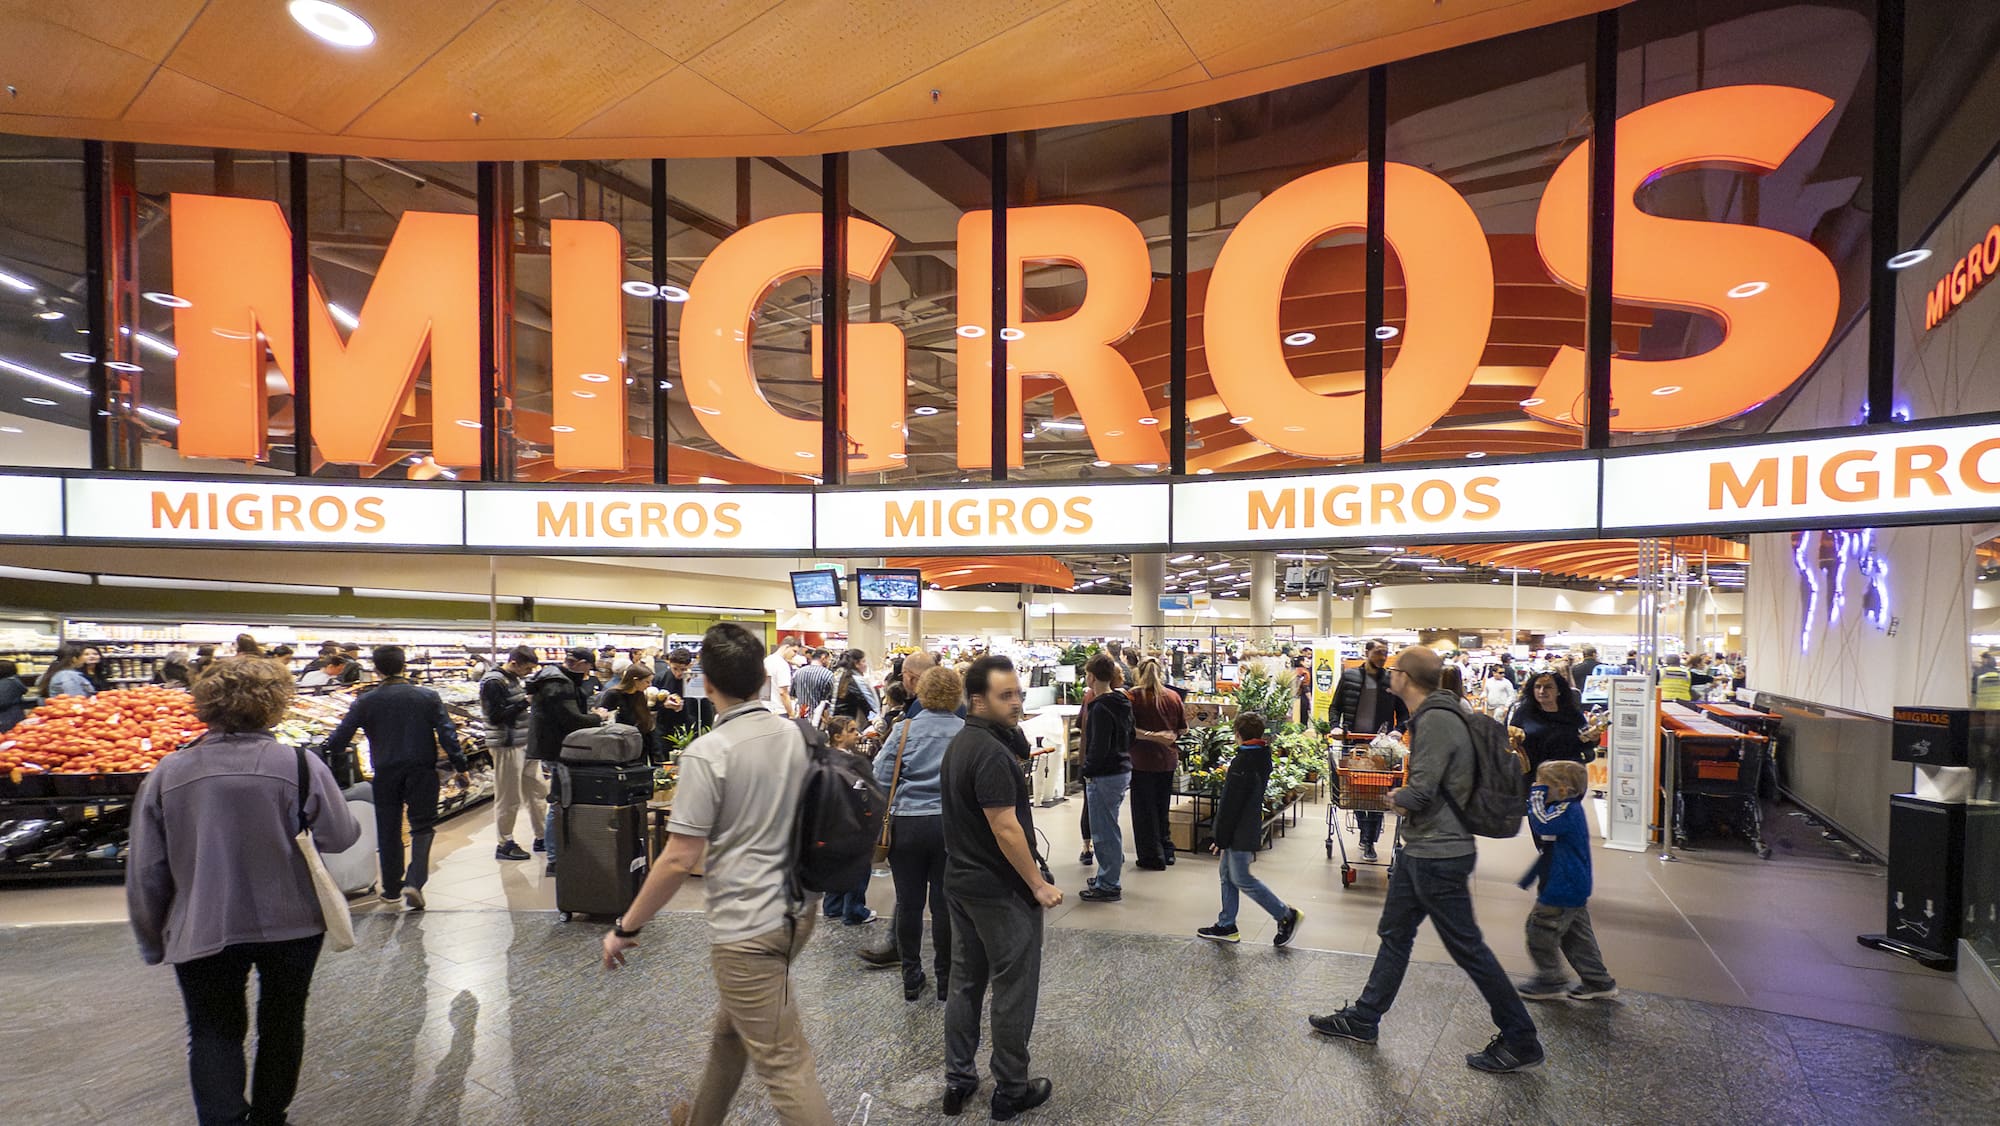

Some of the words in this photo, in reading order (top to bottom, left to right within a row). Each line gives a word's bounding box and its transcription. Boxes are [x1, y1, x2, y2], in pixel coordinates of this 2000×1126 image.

[170, 84, 1841, 474] MIGROS
[151, 491, 386, 533] MIGROS
[537, 501, 741, 539] MIGROS
[885, 496, 1093, 538] MIGROS
[1248, 476, 1501, 531] MIGROS
[1895, 711, 1950, 724] MIGROS
